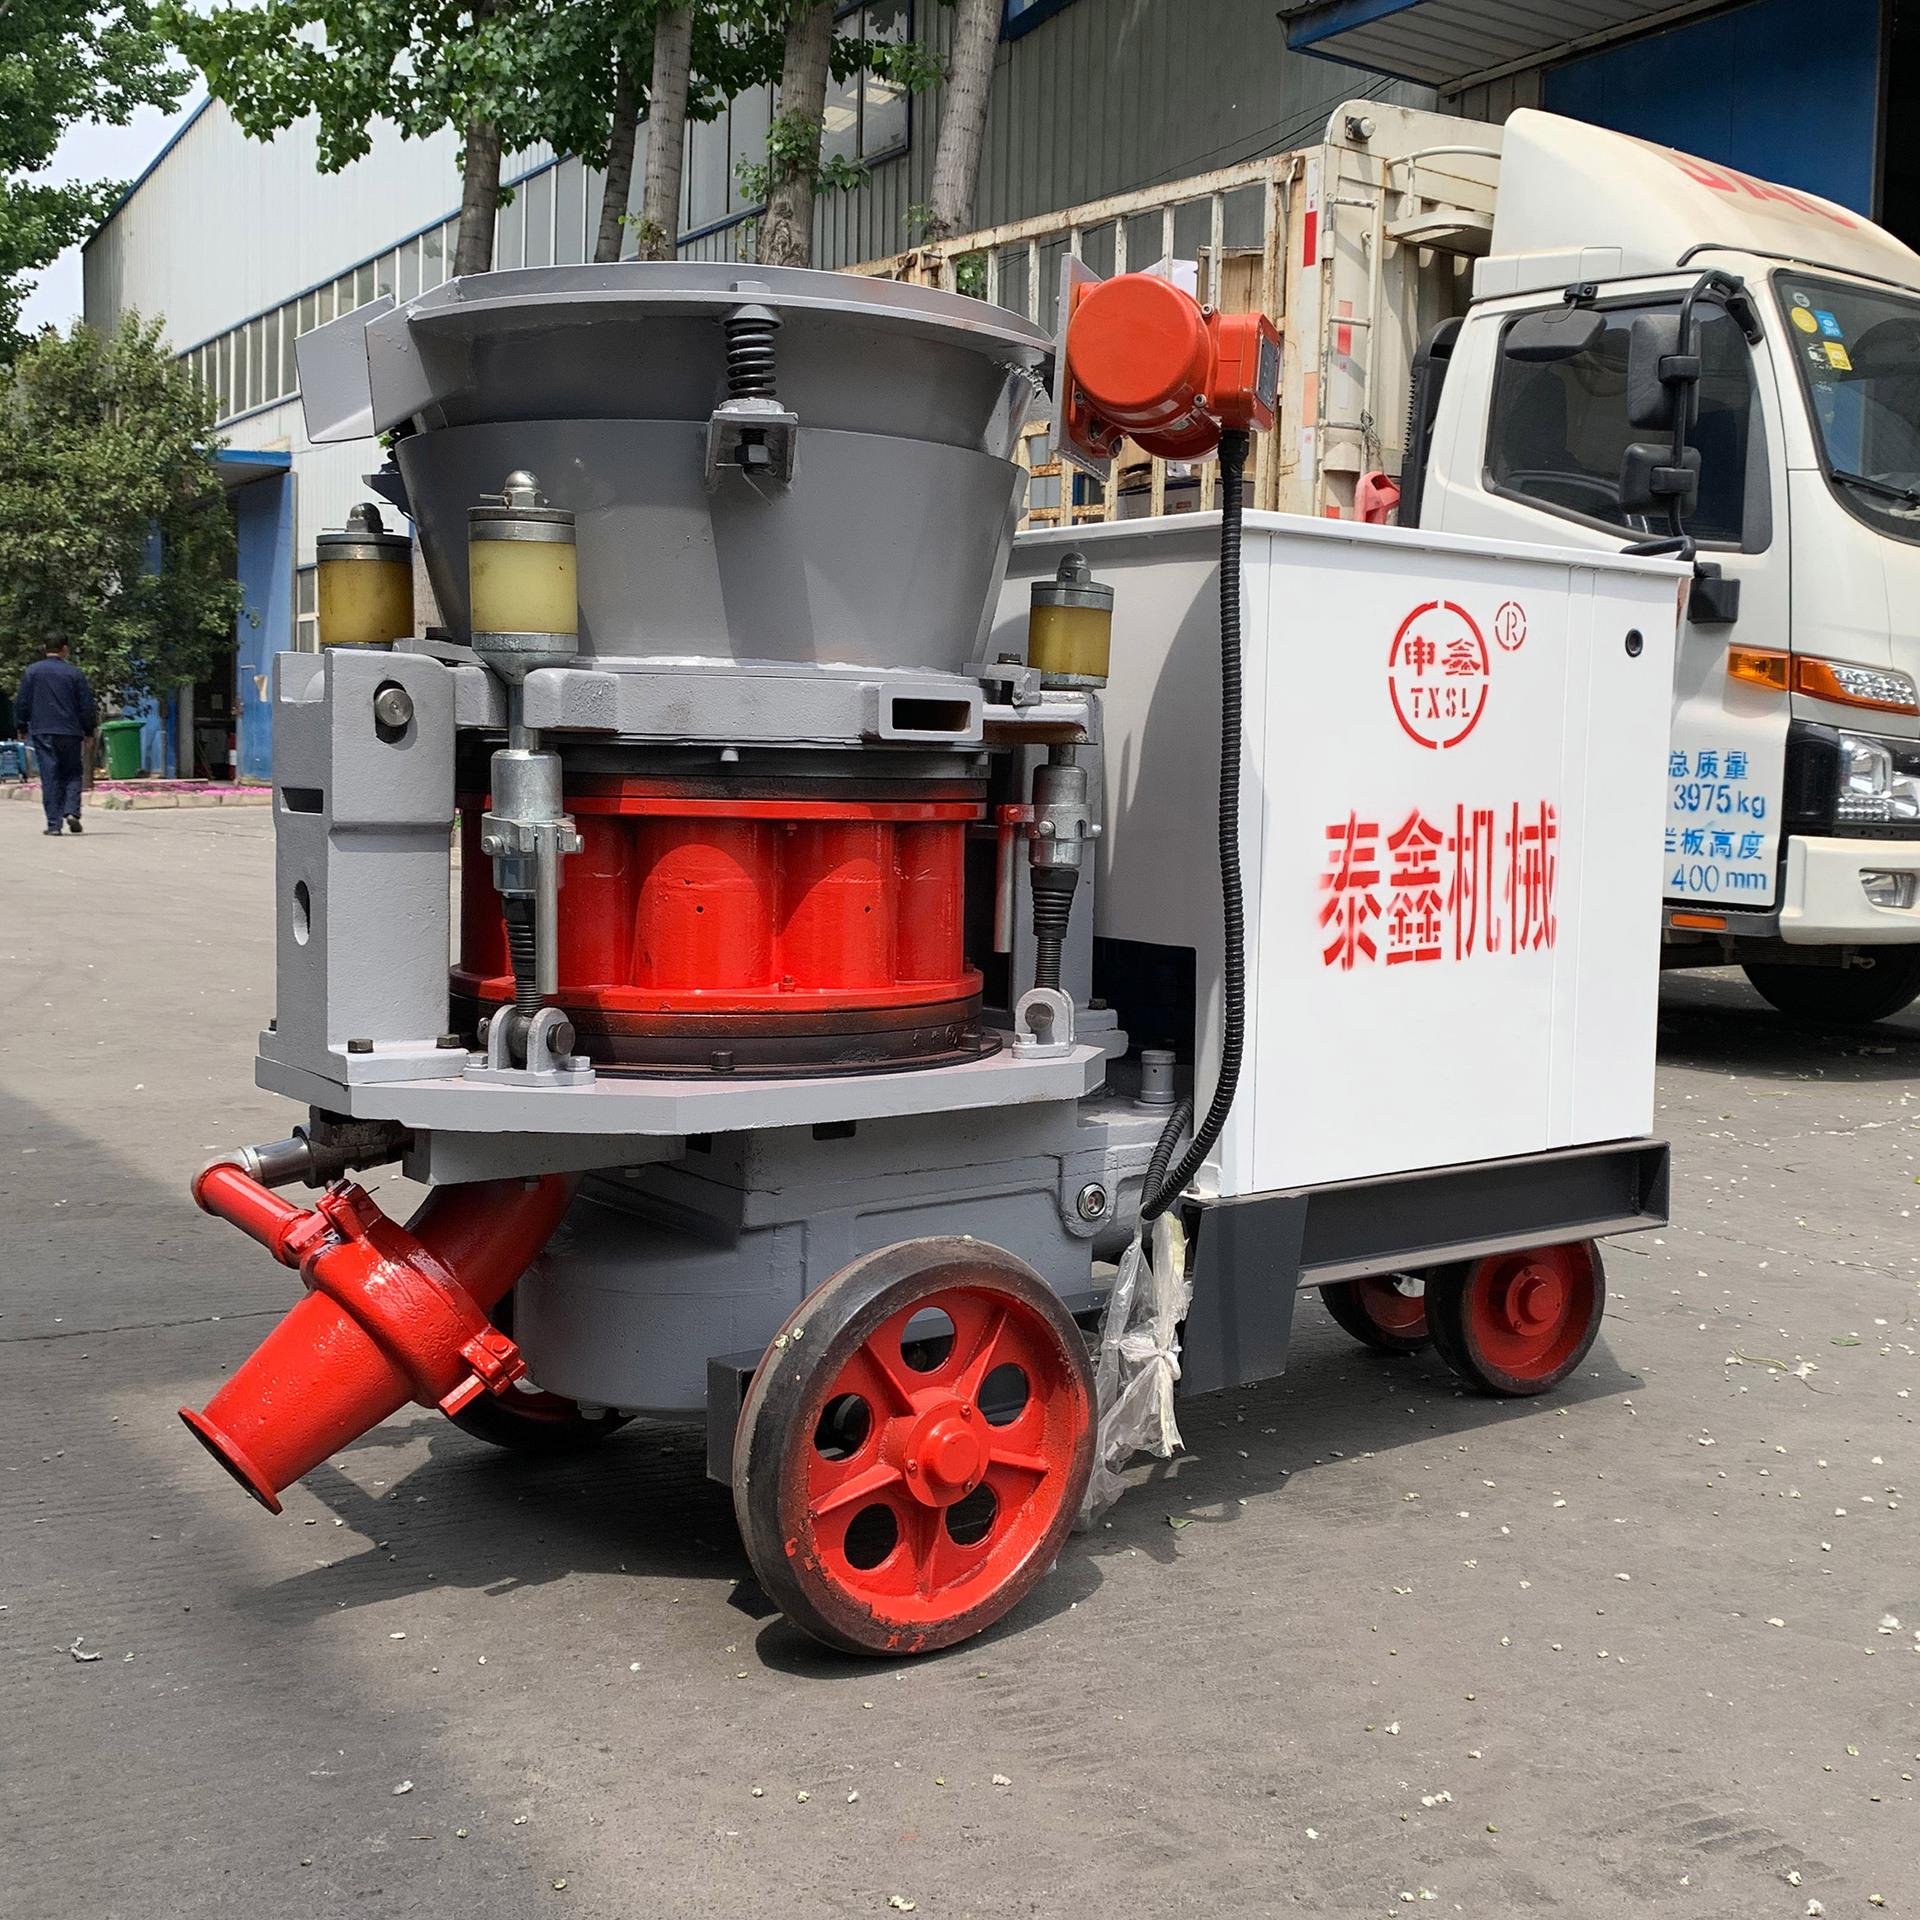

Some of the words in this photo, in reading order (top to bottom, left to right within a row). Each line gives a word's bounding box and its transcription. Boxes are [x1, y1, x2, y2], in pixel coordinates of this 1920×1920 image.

[1410, 687, 1471, 719] TXSL
[1668, 750, 1749, 780] 总质量
[1318, 801, 1557, 970] 泰鑫机械
